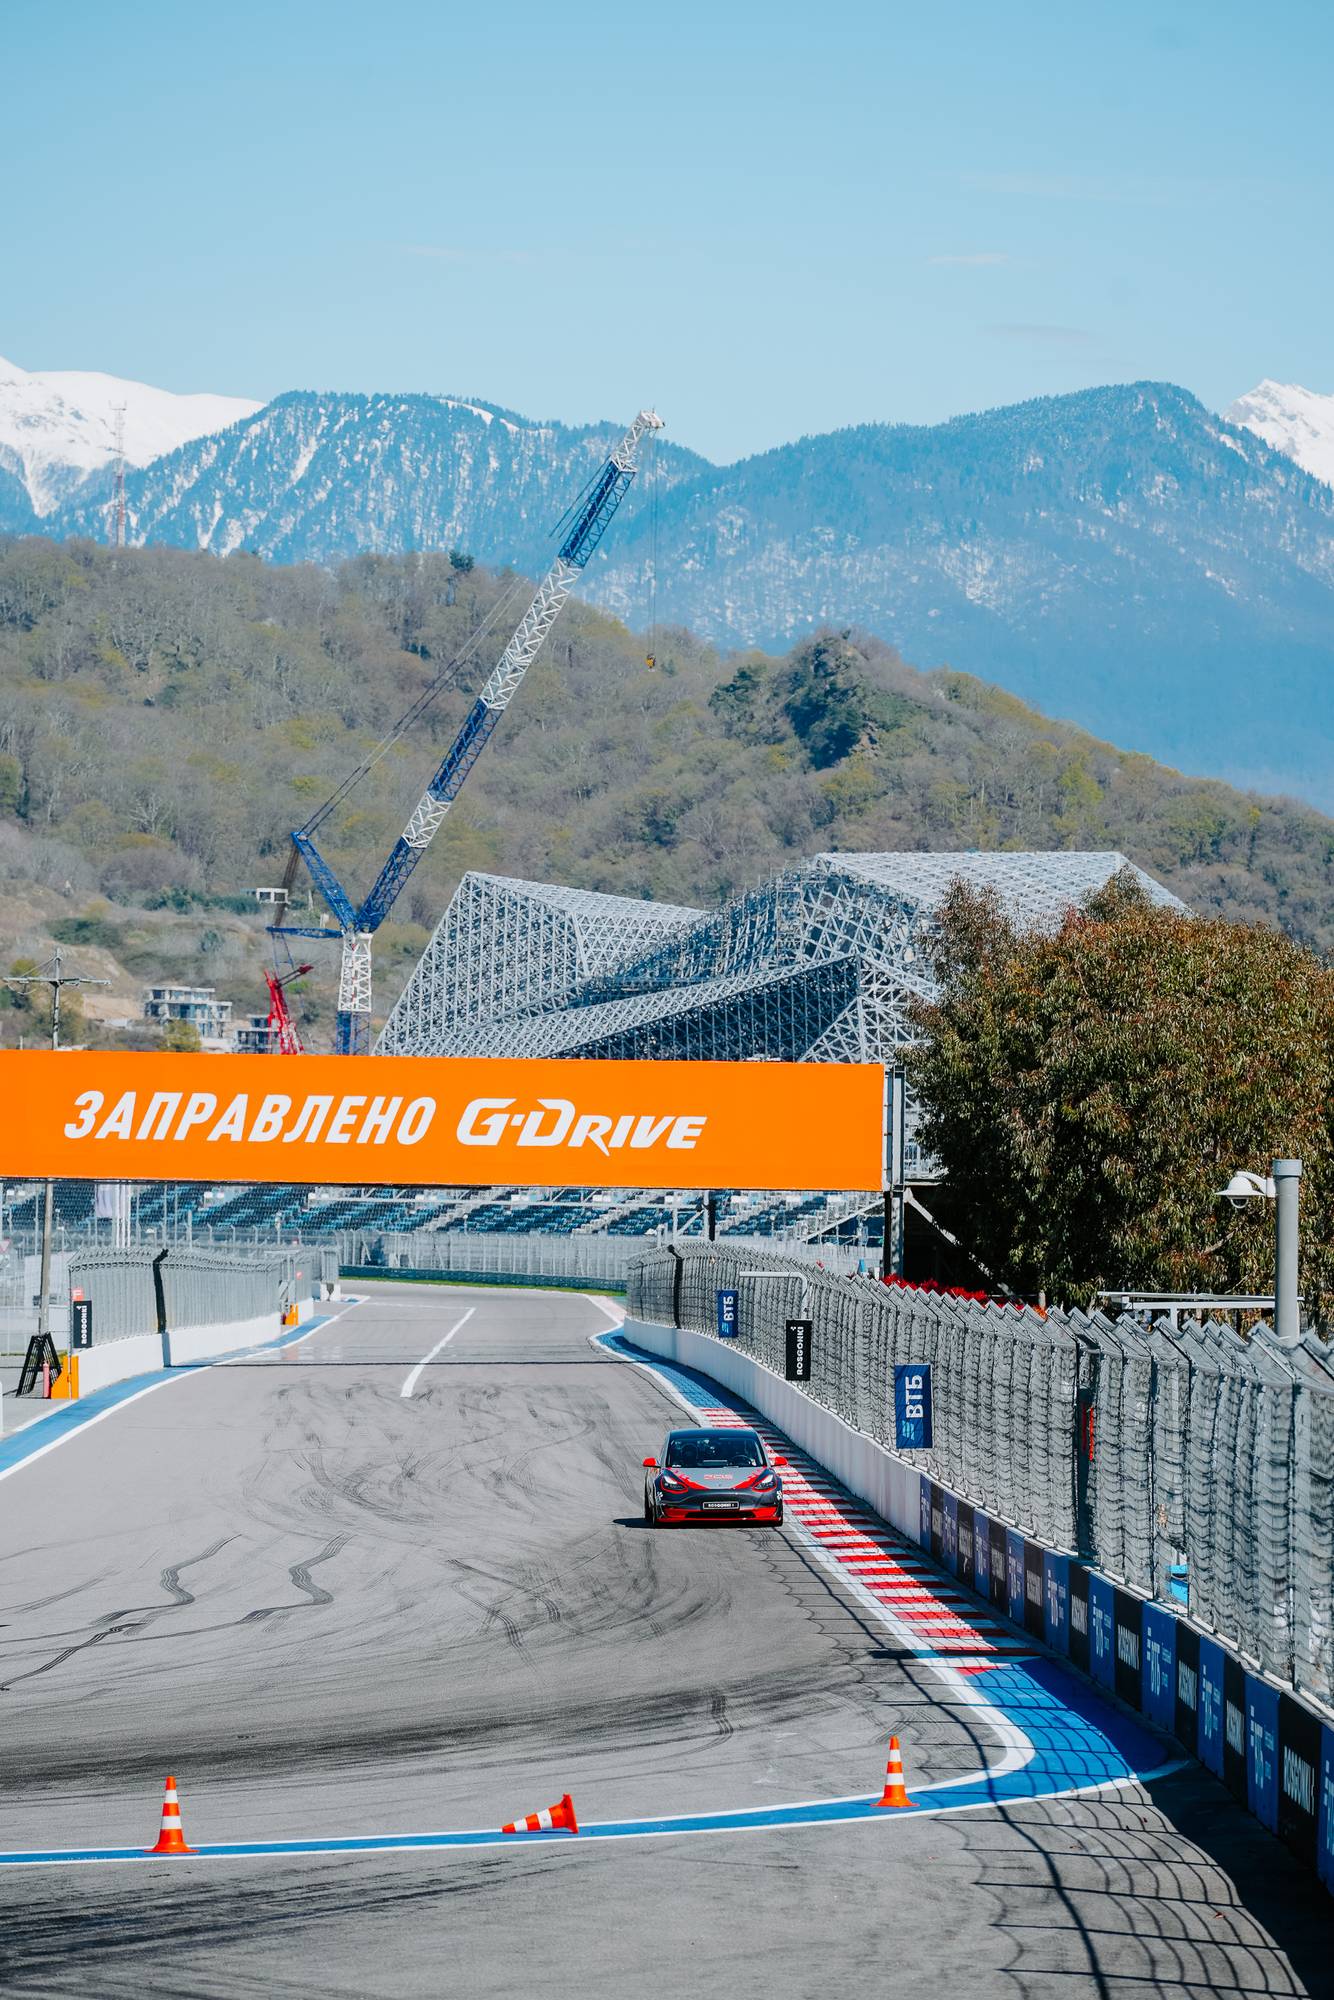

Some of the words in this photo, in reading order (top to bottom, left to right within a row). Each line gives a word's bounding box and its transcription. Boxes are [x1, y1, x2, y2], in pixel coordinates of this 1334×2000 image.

[64, 1090, 437, 1145] ЗАПРАВЛЕНО
[723, 1296, 735, 1321] ВТБ
[796, 1326, 804, 1376] ROSGONKI
[905, 1374, 924, 1419] ВТБ
